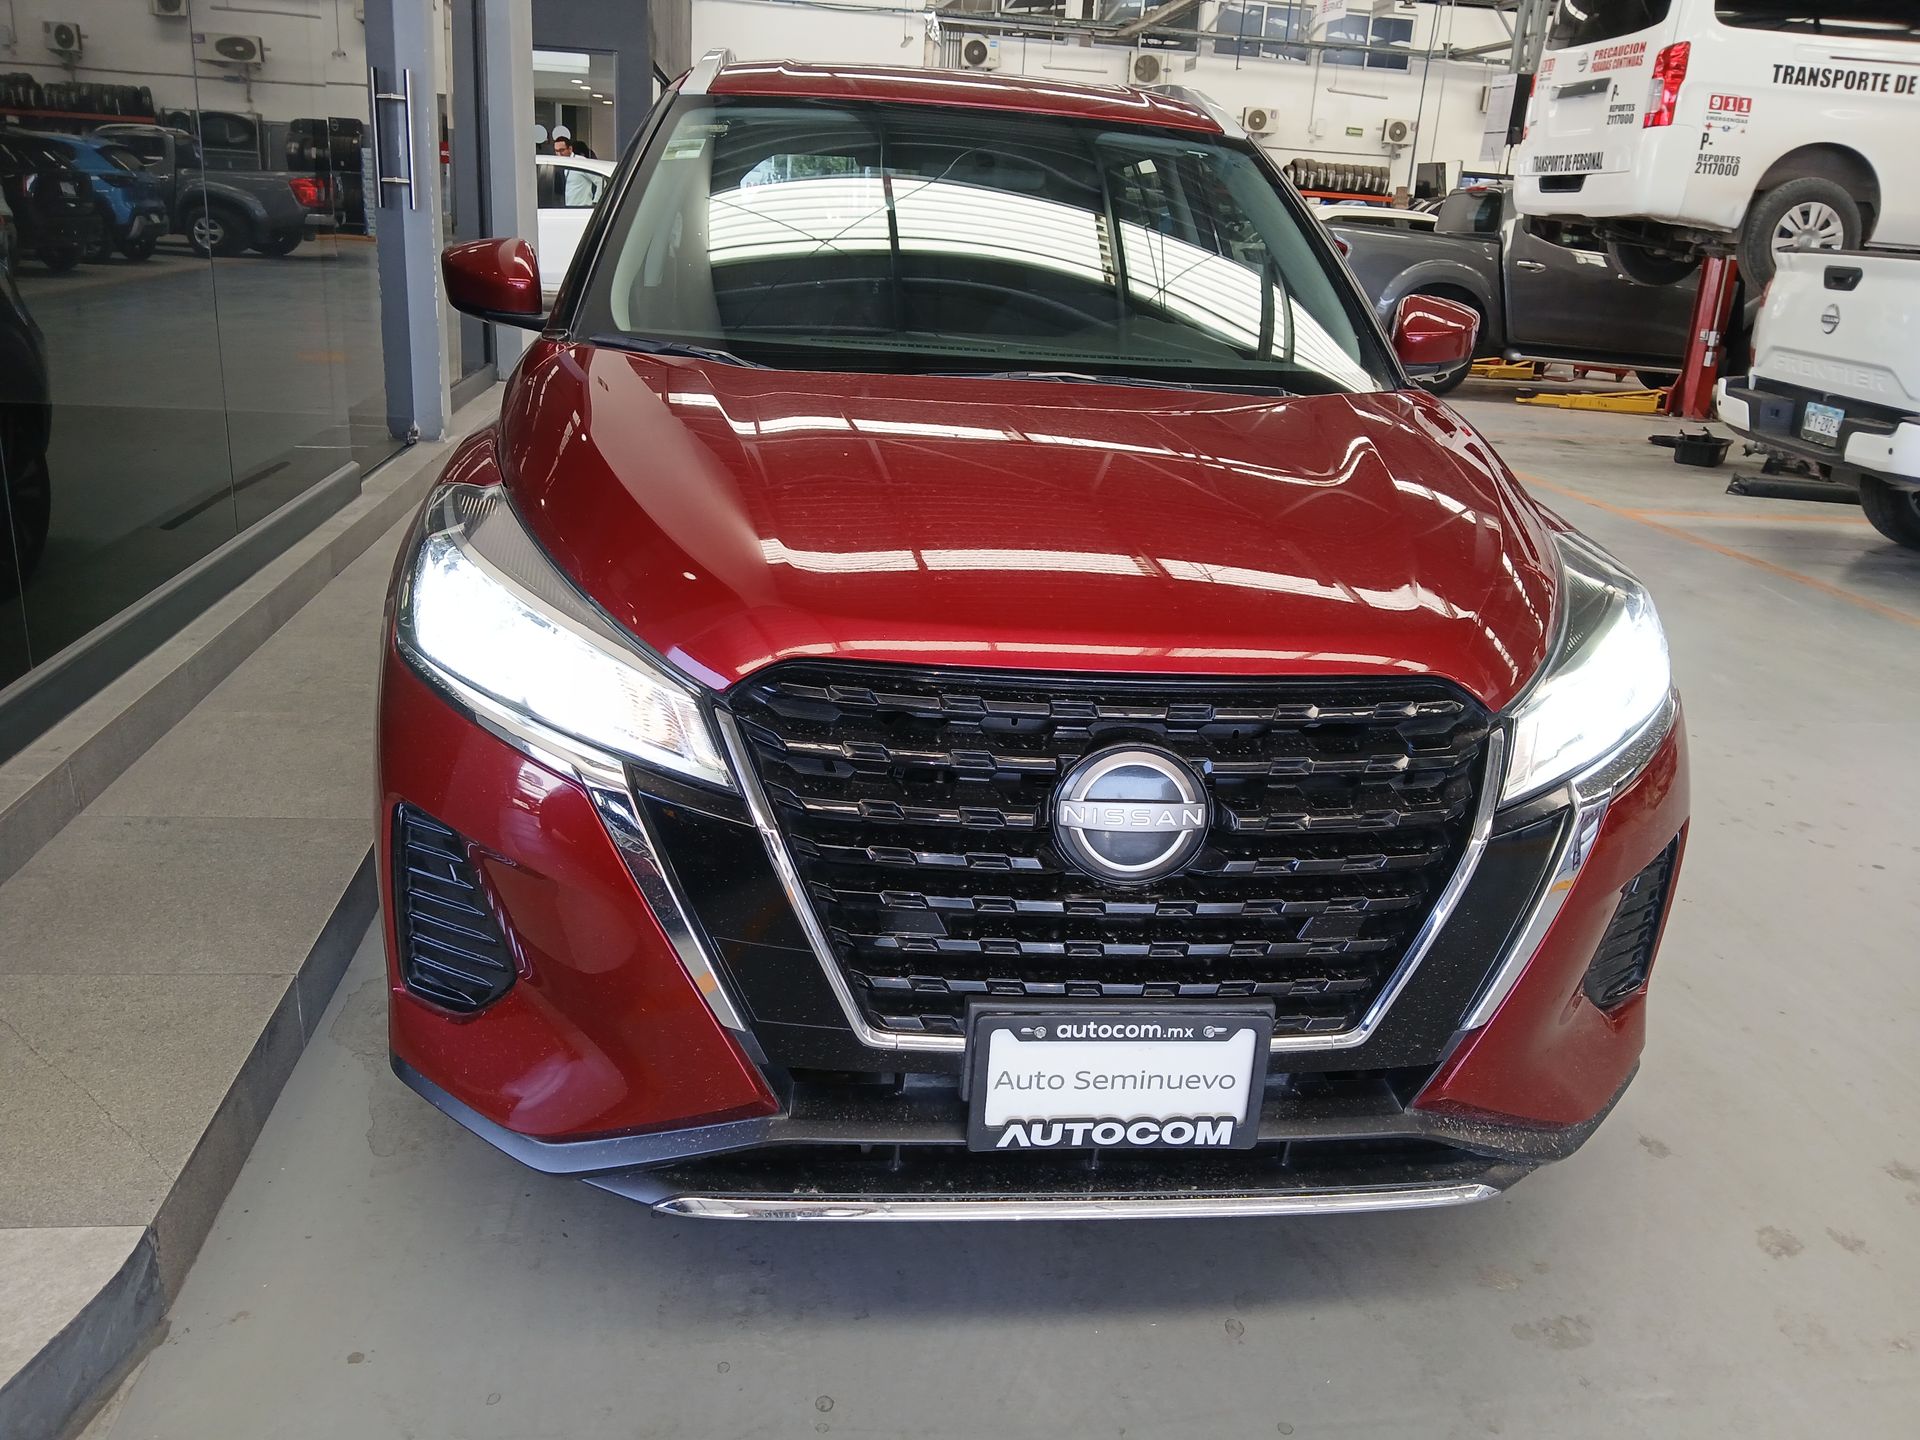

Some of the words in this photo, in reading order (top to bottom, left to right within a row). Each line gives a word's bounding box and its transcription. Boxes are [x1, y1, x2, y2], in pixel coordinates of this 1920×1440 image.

[1594, 42, 1647, 60] PRECAUCION
[1773, 64, 1891, 92] TRANSPORTE
[1894, 74, 1918, 95] DE
[1609, 104, 1635, 112] REPORTES
[1709, 95, 1751, 112] 911
[1607, 113, 1635, 125] 2117000
[1532, 155, 1565, 172] TRANSPORTE
[1564, 154, 1572, 171] DE
[1572, 152, 1604, 170] PERSONAL
[1697, 153, 1741, 164] REPORTES
[1694, 161, 1740, 176] 2117000
[1773, 352, 1888, 392] FRONTIER
[1063, 805, 1203, 826] NISSAN
[1056, 1021, 1194, 1039] autocom.mx
[994, 1070, 1065, 1090] Auto
[1073, 1070, 1236, 1090] Seminuevo
[996, 1121, 1234, 1147] AUTOCOM
